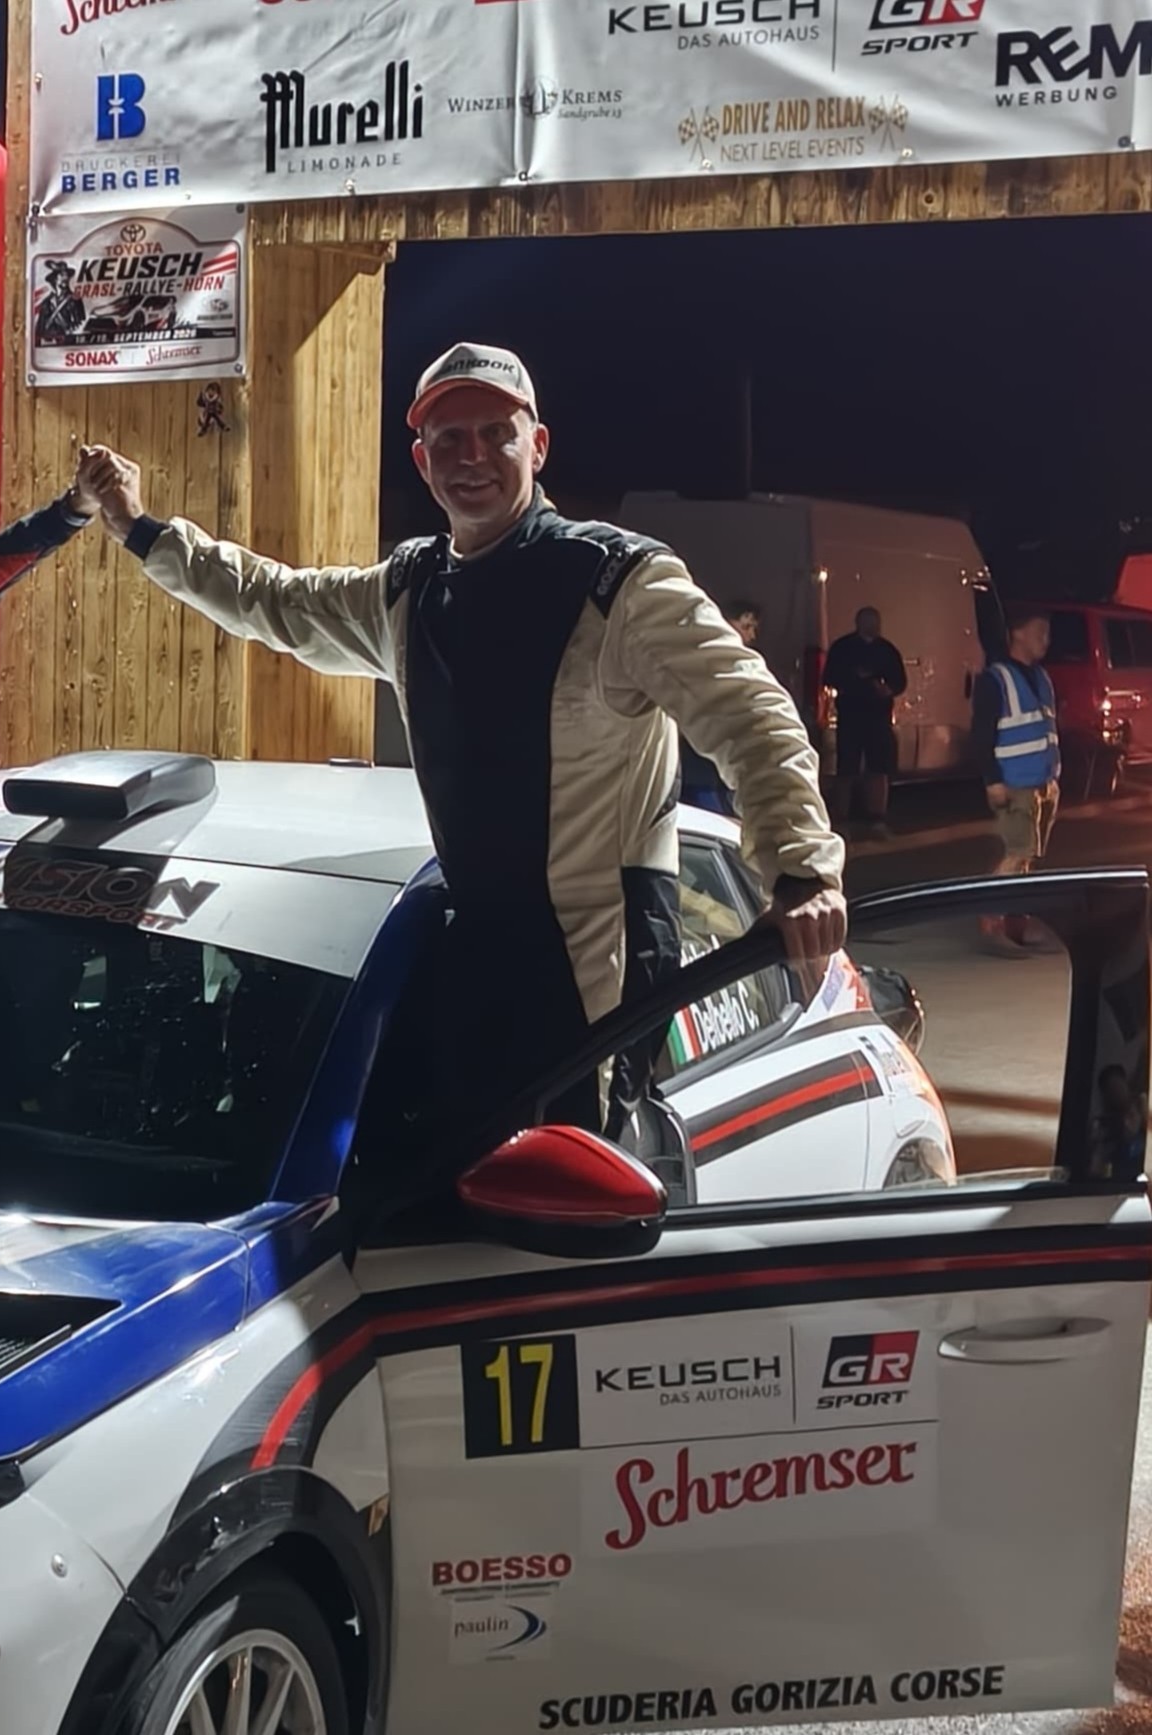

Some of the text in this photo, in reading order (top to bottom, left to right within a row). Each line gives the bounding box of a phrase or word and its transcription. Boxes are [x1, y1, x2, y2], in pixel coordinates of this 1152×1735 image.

[609, 0, 820, 34] KEUSCH
[678, 25, 820, 50] DAS AUTOHAUS
[861, 31, 979, 56] SPORT
[995, 86, 1118, 107] WERBUNG
[260, 60, 423, 173] Murelli
[722, 95, 866, 136] DRIVE AND RELAX
[720, 136, 865, 162] NEXT LEVEL EVENTS
[61, 152, 181, 172] DRUCKEREI
[287, 153, 401, 174] LIMONADE
[61, 167, 181, 193] BERGER
[105, 242, 164, 256] TOYOTA
[77, 252, 203, 283] KEUSCH
[73, 275, 225, 298] GRASL-RALLYE-HORN
[113, 330, 171, 343] SEPTEMBER
[65, 350, 119, 367] SONAX
[485, 1344, 910, 1446] 17 KEUSCH GR
[659, 1384, 781, 1407] DAS AUTOHAUS
[816, 1390, 909, 1410] SPORT
[605, 1441, 917, 1549] Schremser
[432, 1553, 572, 1586] BOESSO
[454, 1617, 509, 1638] paulin
[538, 1665, 1005, 1730] SCUDERIA GORIZIA CORSE
